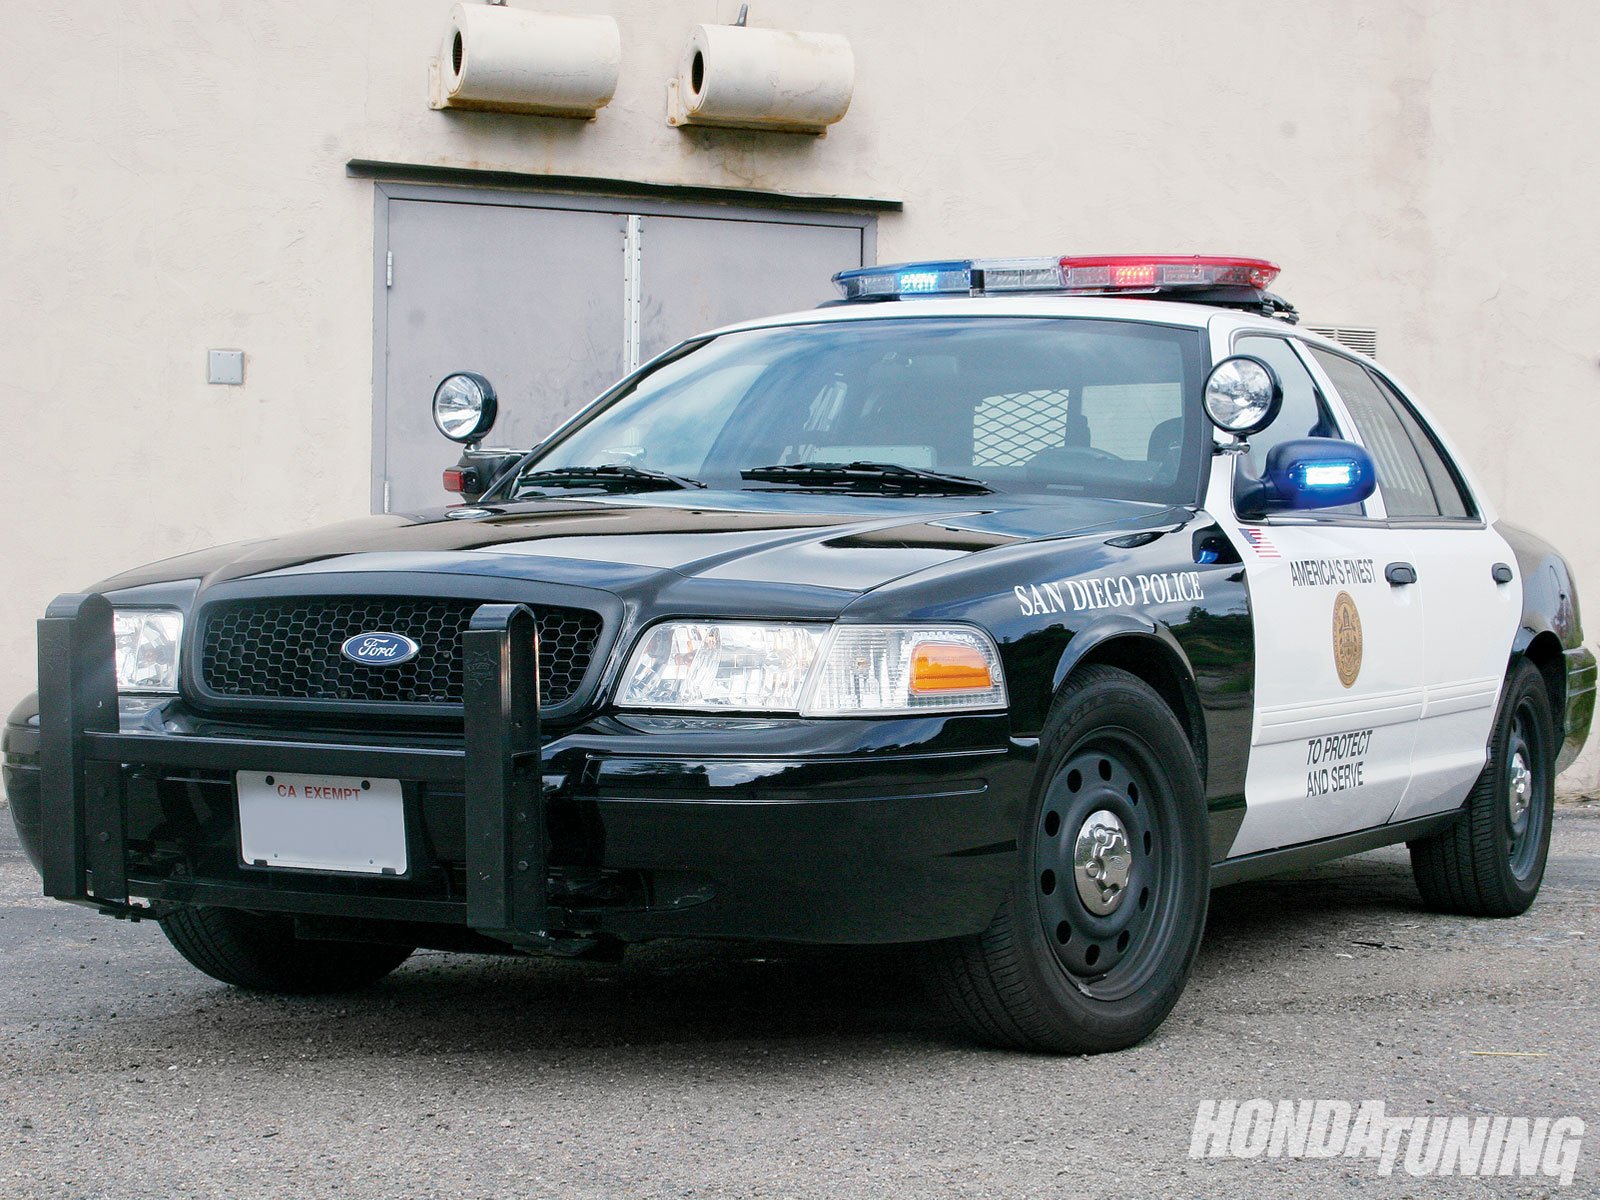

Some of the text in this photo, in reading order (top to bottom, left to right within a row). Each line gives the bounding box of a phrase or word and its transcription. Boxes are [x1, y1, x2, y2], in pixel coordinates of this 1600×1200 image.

[1289, 558, 1376, 586] AMERICA'S FINEST
[1014, 571, 1205, 617] SAN DIEGO POLICE
[358, 637, 399, 657] Ford
[1306, 729, 1373, 766] TO PROTECT
[277, 784, 361, 801] CA EXEMPT
[1306, 761, 1364, 798] AND SERVE
